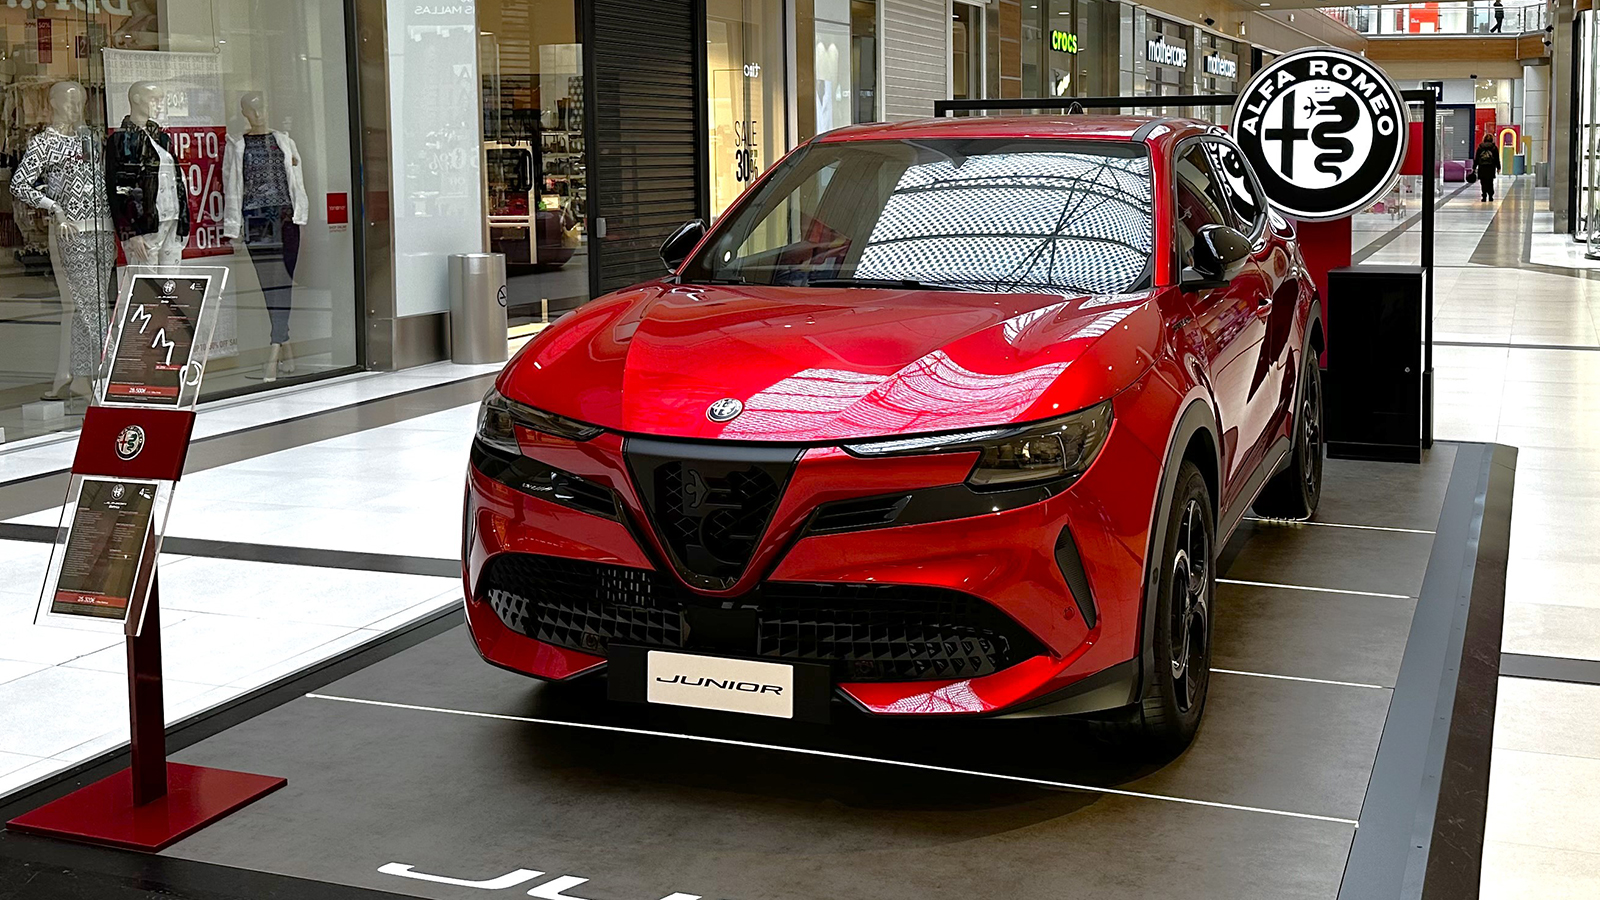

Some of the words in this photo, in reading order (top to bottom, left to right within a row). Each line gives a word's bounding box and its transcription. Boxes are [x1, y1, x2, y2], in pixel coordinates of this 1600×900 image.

[1052, 29, 1078, 54] crocs
[1148, 35, 1187, 68] mothercare
[1207, 51, 1236, 79] mothercare
[1242, 70, 1296, 135] ALFA
[1309, 60, 1394, 136] ROMEO
[194, 131, 219, 159] TO
[734, 120, 757, 148] SALE
[735, 149, 758, 182] 30%
[196, 226, 225, 250] OFF
[656, 674, 784, 695] JUNIOR
